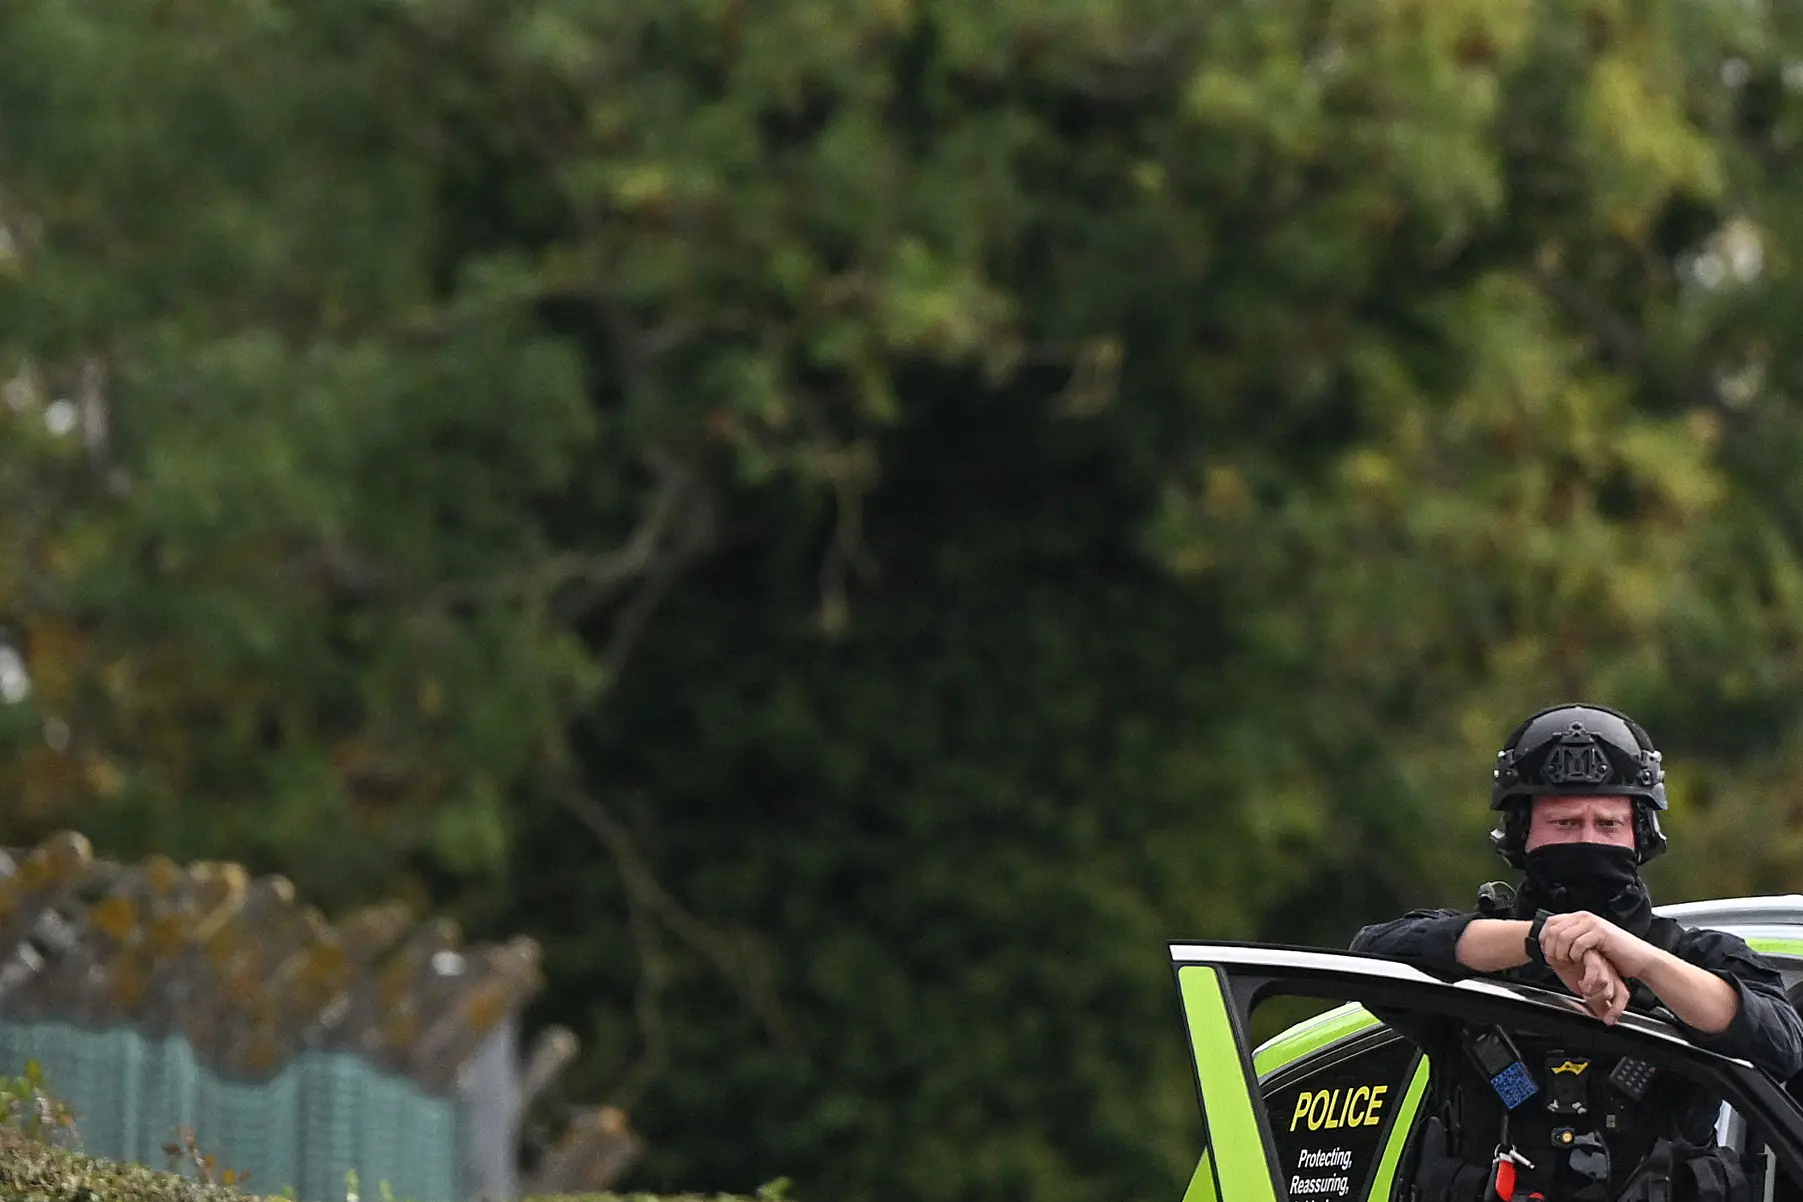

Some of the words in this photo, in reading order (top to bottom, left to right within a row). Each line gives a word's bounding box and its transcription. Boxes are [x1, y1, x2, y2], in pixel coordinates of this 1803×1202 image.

[1290, 1085, 1388, 1132] POLICE
[1297, 1146, 1352, 1170] Protecting,
[1289, 1173, 1349, 1196] Reassuring,
